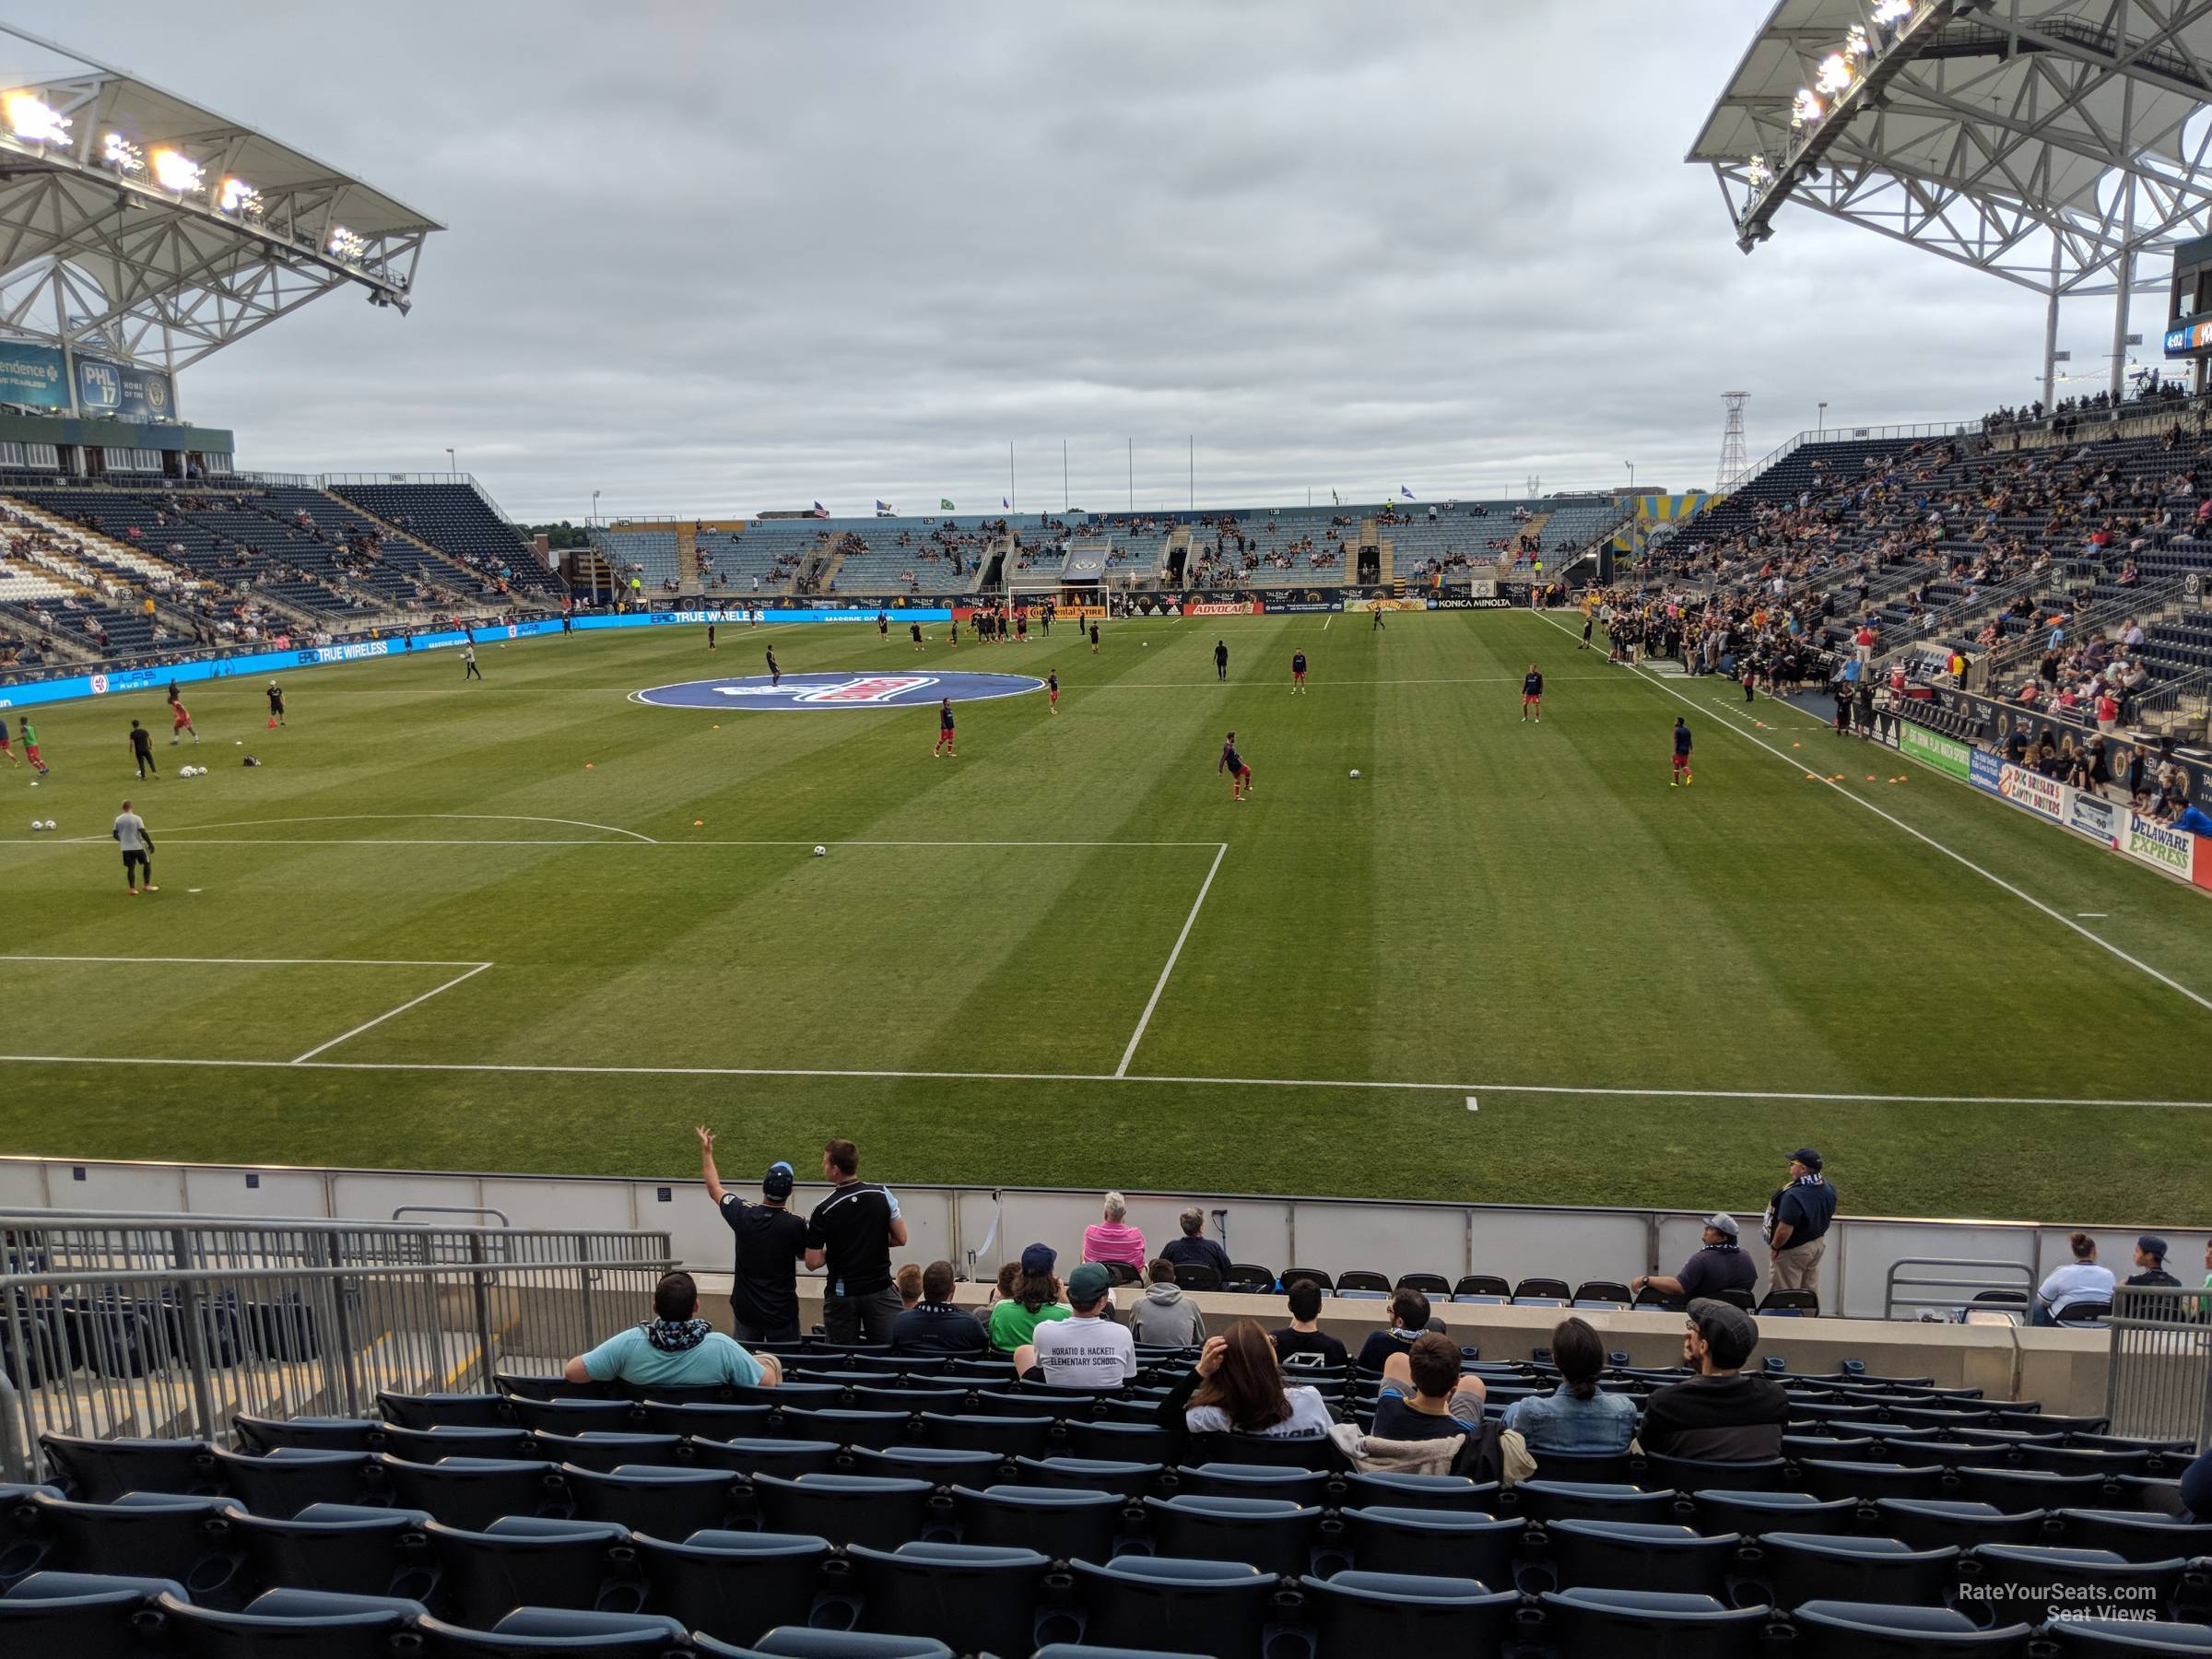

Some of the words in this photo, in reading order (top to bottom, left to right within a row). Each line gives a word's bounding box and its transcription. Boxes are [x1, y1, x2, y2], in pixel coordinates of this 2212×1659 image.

[86, 368, 116, 387] PHL
[124, 382, 143, 391] HOME
[102, 382, 116, 404] 17
[56, 477, 66, 486] 130
[1439, 600, 1472, 608] KONICA
[1474, 599, 1511, 608] MINOLTA
[1194, 604, 1253, 615] ADVOCAE
[675, 612, 703, 622] TRUE
[317, 647, 343, 662] TRUE
[343, 641, 388, 660] WIRELESS
[2130, 813, 2190, 853] DELAWARE
[2129, 832, 2189, 870] EXPRESS
[1052, 1347, 1078, 1356] HORATIO
[1088, 1347, 1115, 1356] HACKETT
[1051, 1358, 1090, 1366] ELEMENTARY
